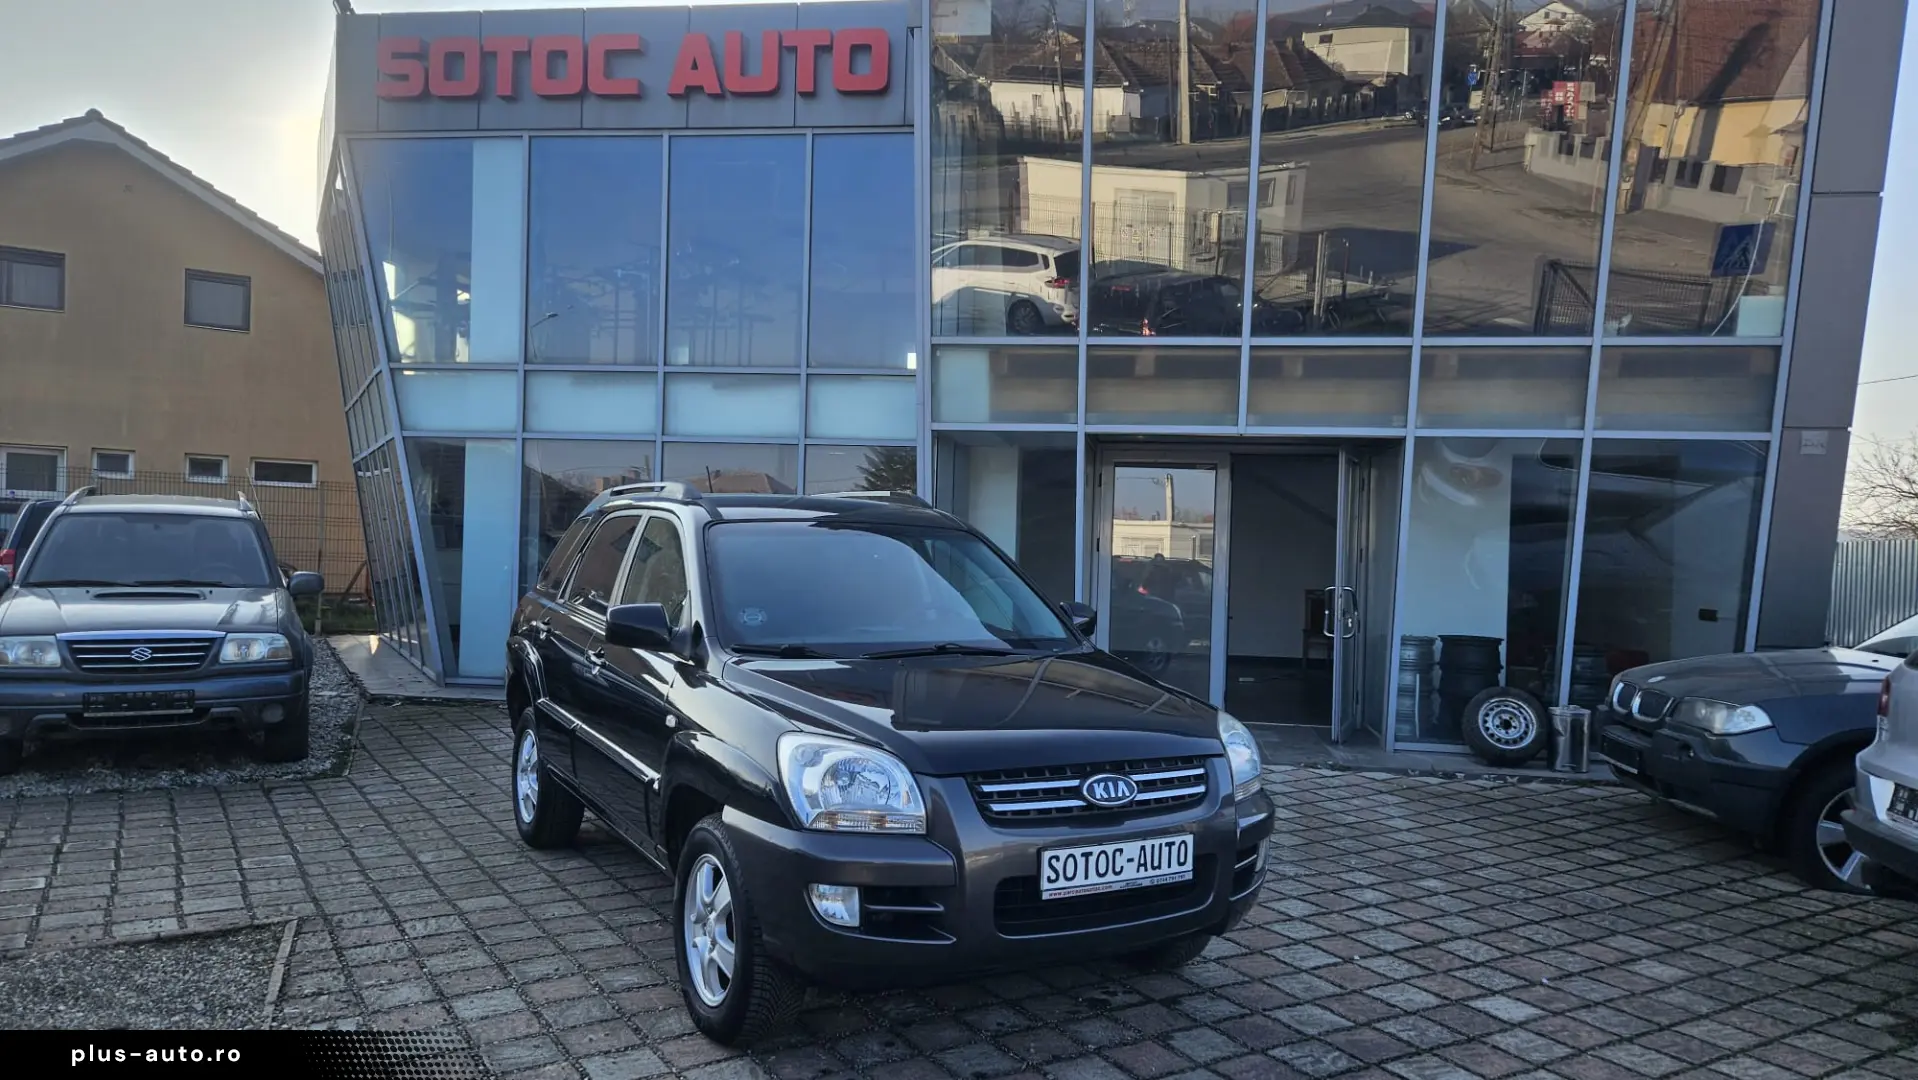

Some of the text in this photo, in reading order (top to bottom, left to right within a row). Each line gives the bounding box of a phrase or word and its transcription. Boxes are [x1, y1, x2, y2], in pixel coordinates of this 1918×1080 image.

[376, 28, 891, 99] SOTOC AUTO
[1092, 780, 1131, 799] KIA
[1047, 840, 1188, 884] SOTOC-AUTO
